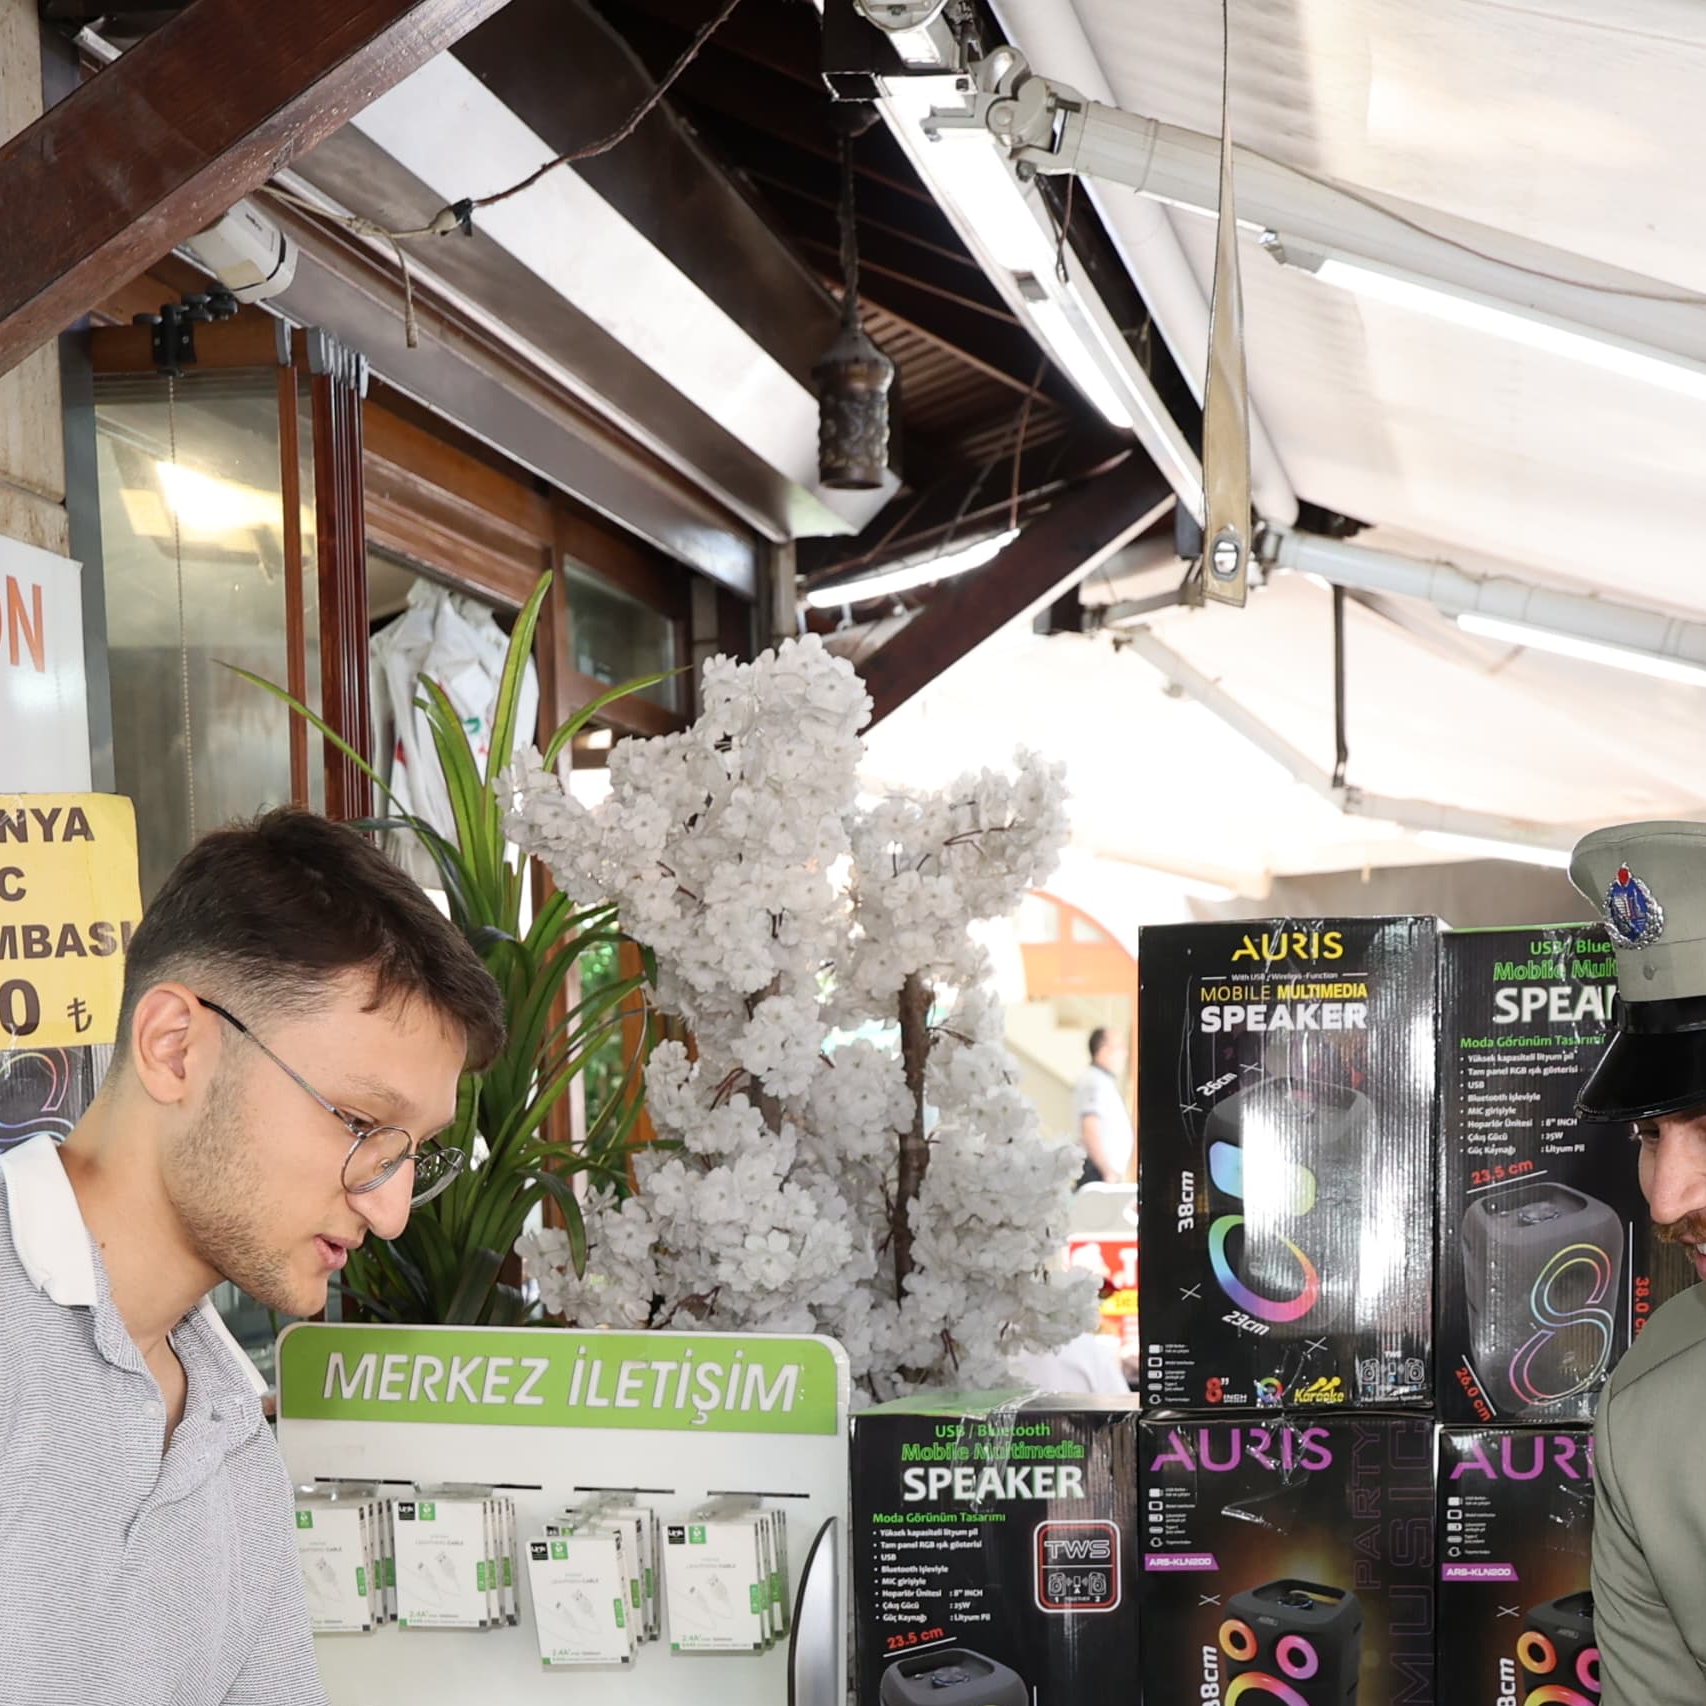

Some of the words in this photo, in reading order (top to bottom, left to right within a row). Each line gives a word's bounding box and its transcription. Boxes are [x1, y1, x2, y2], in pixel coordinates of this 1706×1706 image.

[1230, 931, 1345, 962] AURIS
[1200, 984, 1272, 1002] MOBILE
[1276, 982, 1369, 1000] MULTIMEDIA
[1200, 1002, 1369, 1033] SPEAKER
[1460, 1037, 1494, 1049] Moda
[1496, 1035, 1553, 1048] Görünüm
[1196, 1072, 1238, 1097] 26cm
[1467, 1081, 1485, 1089] USB
[1471, 1163, 1506, 1185] 23.5
[1508, 1158, 1534, 1175] cm
[1178, 1170, 1195, 1233] 38cm
[1634, 1276, 1651, 1314] 38.0
[1221, 1310, 1271, 1337] 23cm
[322, 1351, 552, 1406] MERKEZ
[567, 1344, 799, 1425] İLETİŞİM
[1454, 1367, 1479, 1396] 26.0
[1472, 1397, 1492, 1423] cm
[935, 1424, 966, 1438] USB
[901, 1442, 970, 1462] Mobile
[973, 1441, 1085, 1461] Multimedia
[1149, 1425, 1334, 1474] AURIS
[902, 1465, 1085, 1502] SPEAKER
[872, 1513, 904, 1523] Moda
[906, 1512, 958, 1524] Görünüm
[959, 1512, 1006, 1523] Tasarımı
[1352, 1421, 1383, 1590] PARTY
[880, 1553, 897, 1561] USB
[1044, 1540, 1111, 1559] TWS
[886, 1631, 918, 1649] 23.5
[920, 1626, 944, 1643] cm
